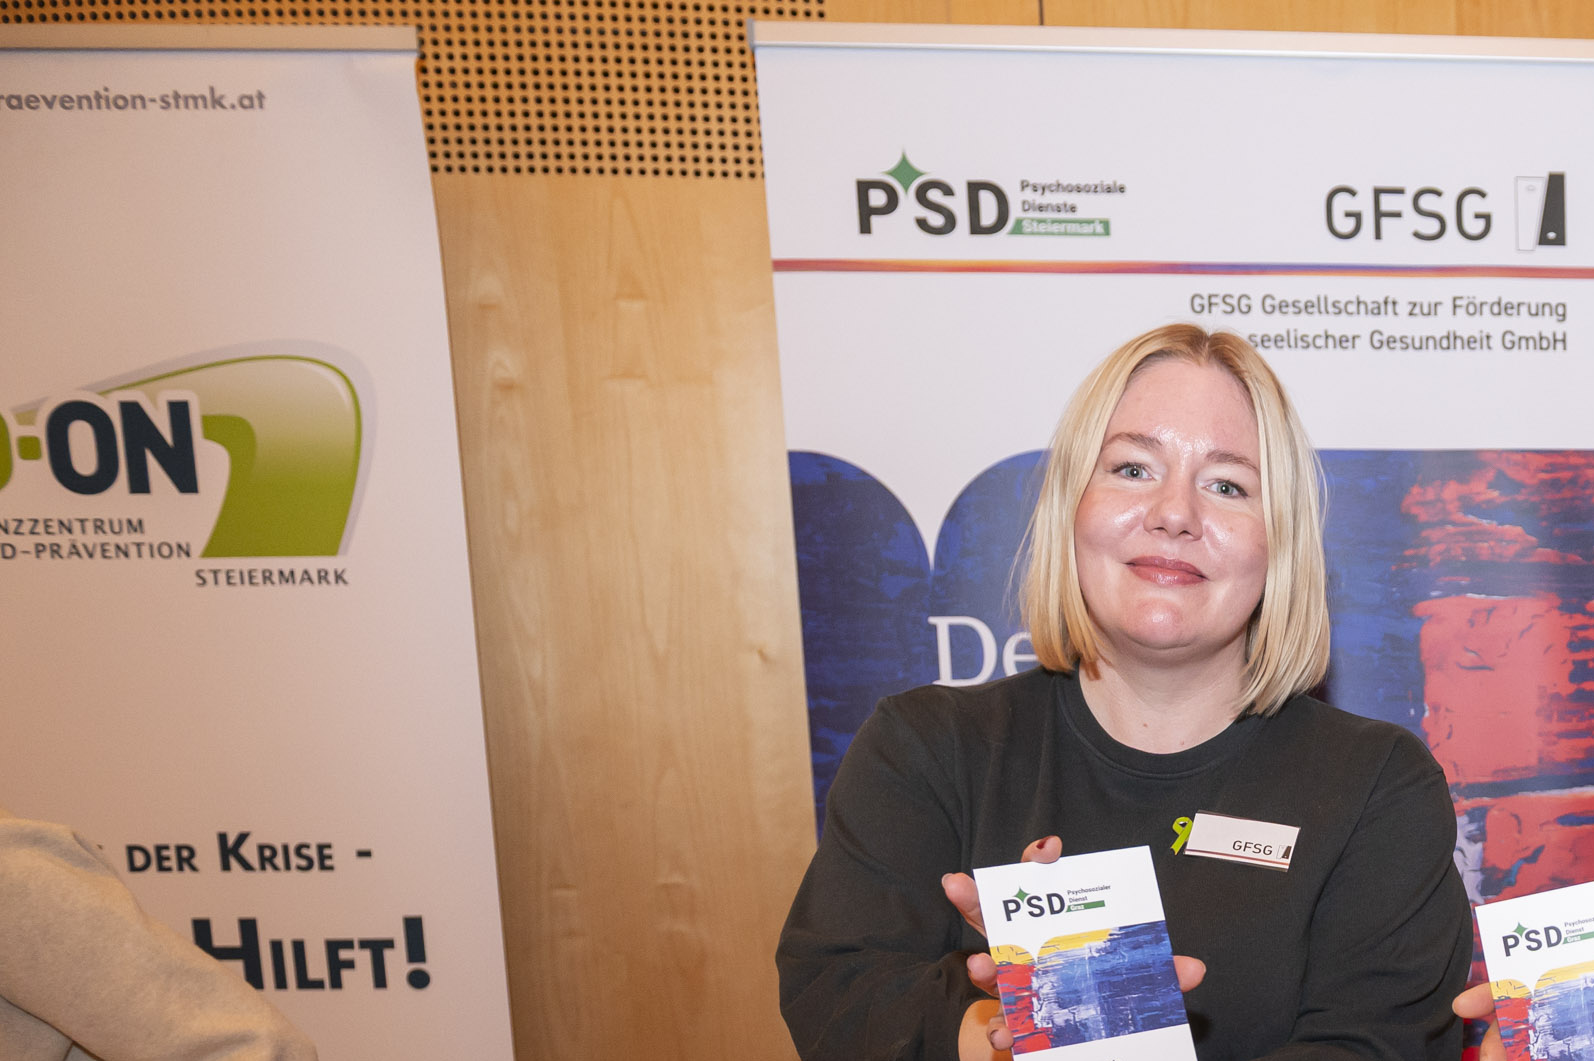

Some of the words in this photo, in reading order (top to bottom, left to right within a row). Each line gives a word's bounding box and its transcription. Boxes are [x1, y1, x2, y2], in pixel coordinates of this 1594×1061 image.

[1021, 179, 1127, 196] Psychosoziale
[856, 178, 1010, 235] PSD
[1022, 200, 1077, 214] Dienste
[1325, 184, 1492, 241] GFSG
[1022, 220, 1105, 234] Steiermark
[1190, 294, 1252, 315] GFSG
[1261, 294, 1398, 317] Gesellschaft
[1408, 299, 1442, 317] zur
[1452, 296, 1567, 322] Förderung
[1248, 330, 1360, 349] seelischer
[1370, 330, 1492, 351] Gesundheit
[1502, 331, 1567, 351] GmbH
[196, 568, 348, 586] STEIERMARK
[1232, 840, 1272, 855] GFSG
[1067, 884, 1111, 896] Psychosozialer
[1002, 893, 1066, 922] PSD
[1069, 895, 1088, 903] Dienst
[1566, 926, 1584, 935] Dienst
[1502, 925, 1562, 957] PSD
